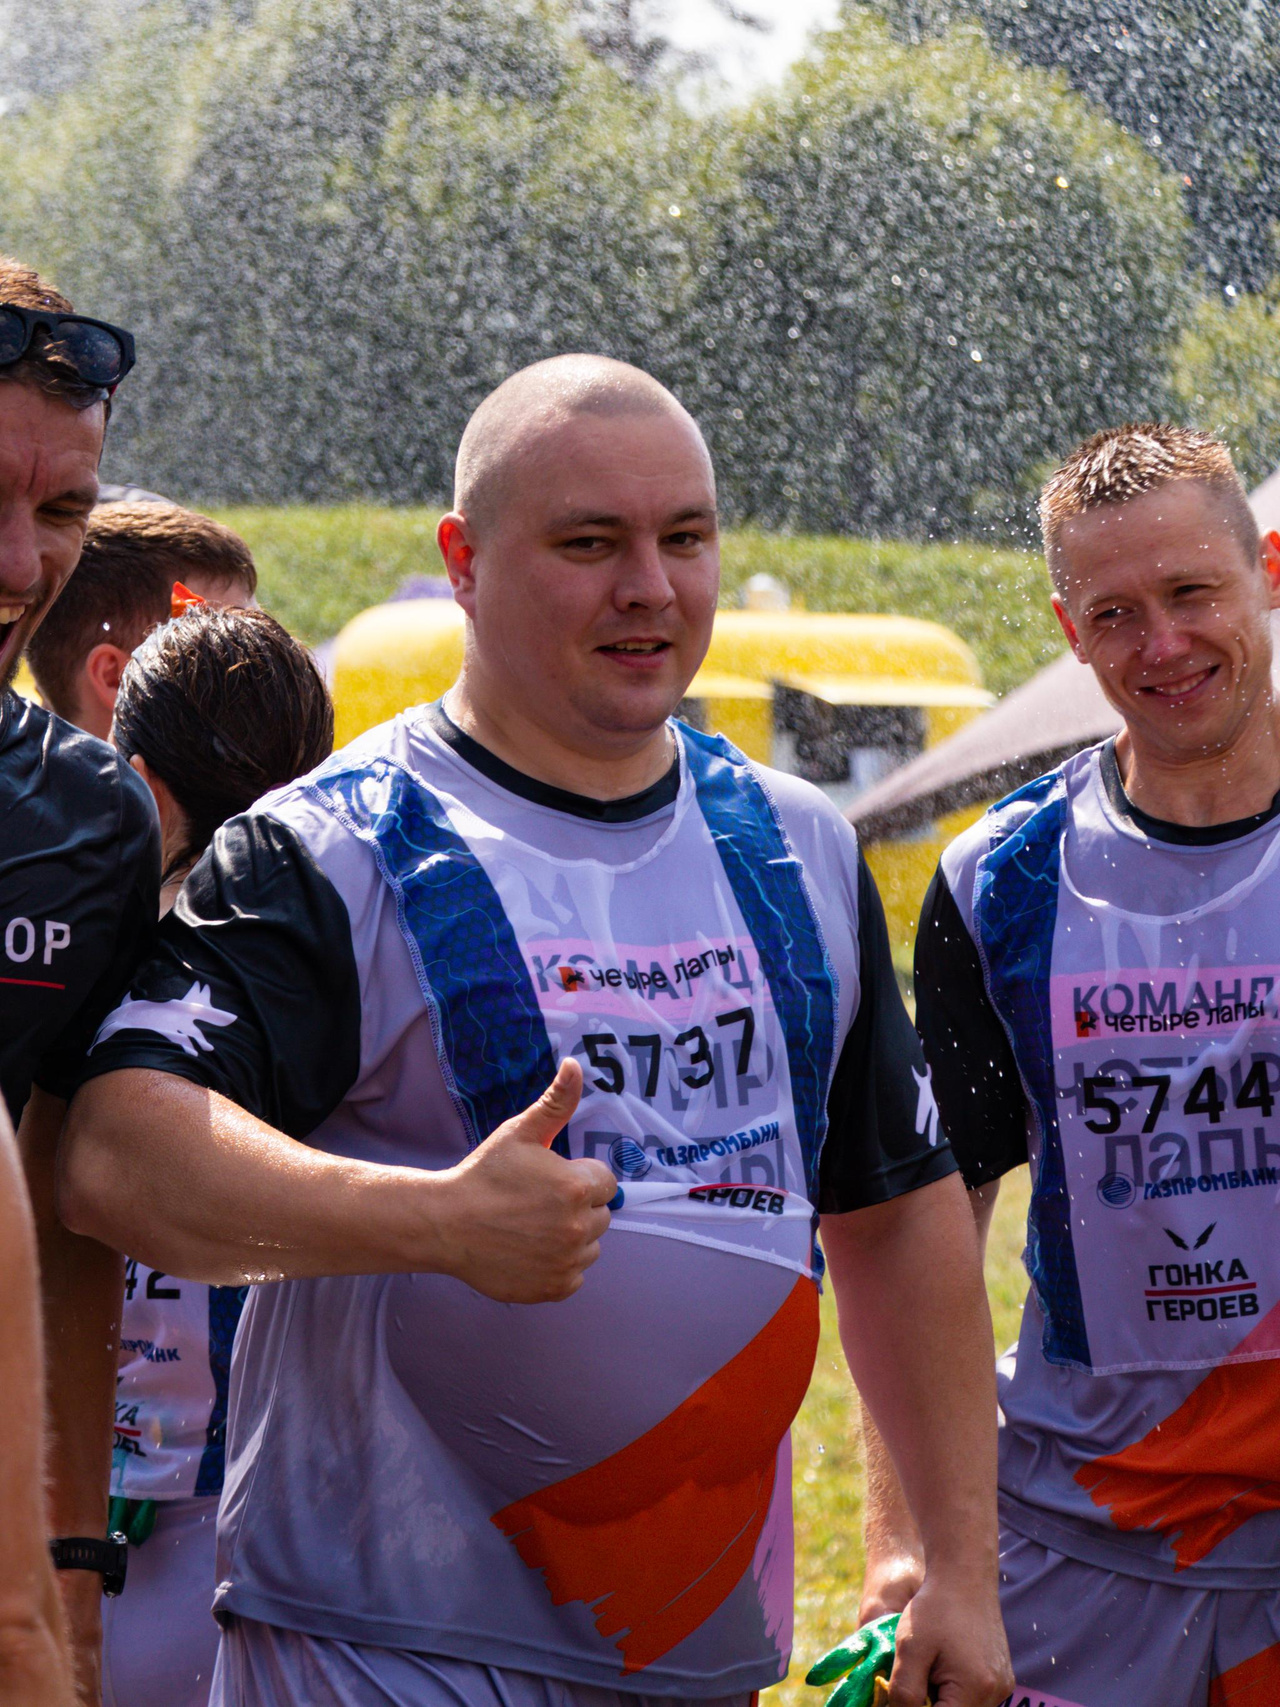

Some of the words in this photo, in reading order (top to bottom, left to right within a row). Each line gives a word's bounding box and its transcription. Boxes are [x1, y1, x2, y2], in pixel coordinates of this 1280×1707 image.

[589, 968, 668, 990] чеыре
[673, 945, 735, 983] лапы
[1104, 1011, 1200, 1033] четыре
[1206, 1000, 1265, 1026] лапы
[582, 1007, 754, 1097] 5737
[1083, 1061, 1275, 1134] 5744
[656, 1121, 780, 1167] ГАЗПРОМБАНК
[1143, 1167, 1278, 1200] ГАЗПРОМБАНК
[1148, 1258, 1250, 1287] ГОНКА
[1145, 1293, 1260, 1321] ГЕРОЕВ
